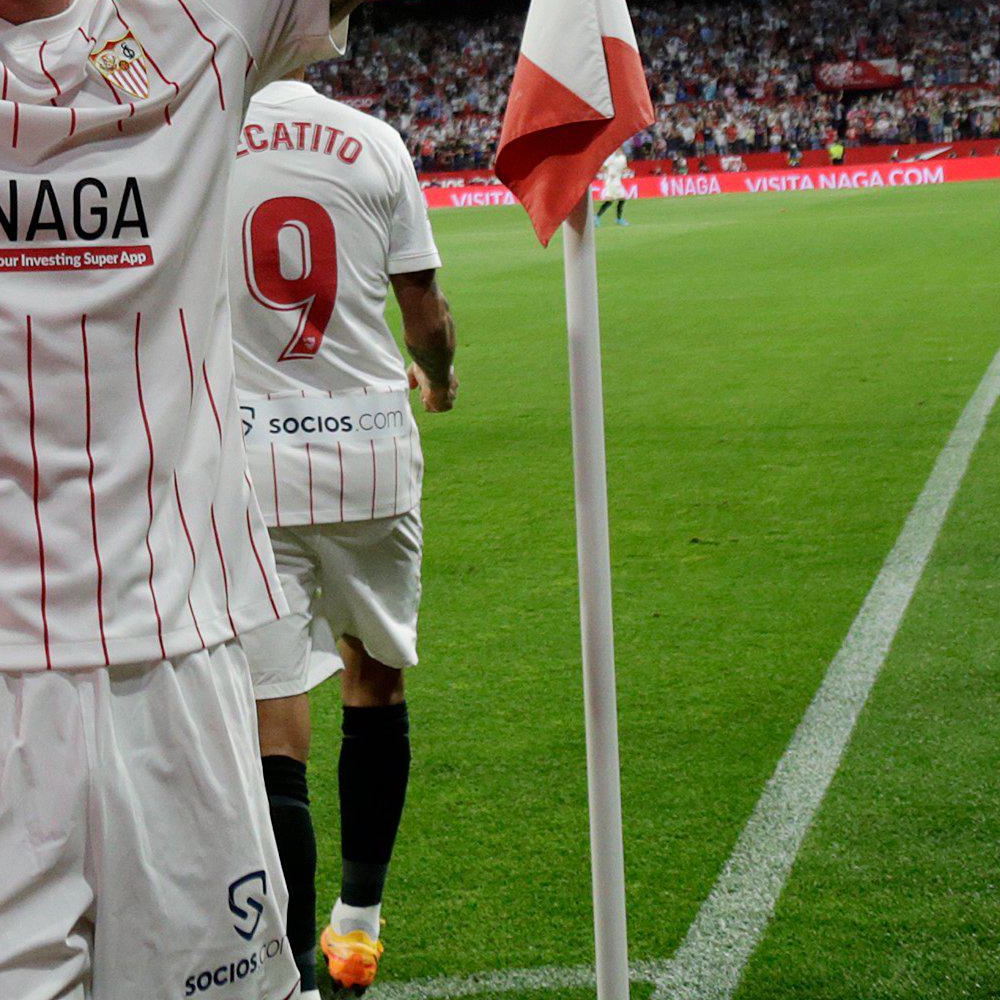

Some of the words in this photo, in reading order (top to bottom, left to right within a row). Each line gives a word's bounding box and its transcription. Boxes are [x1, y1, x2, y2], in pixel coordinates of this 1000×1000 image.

[236, 122, 363, 165] CATITO
[670, 175, 721, 196] NAGA
[745, 174, 815, 192] VISITA
[21, 253, 82, 267] Investing
[83, 252, 118, 268] Super
[120, 251, 147, 265] App
[242, 196, 338, 363] 9
[269, 410, 403, 434] SOCIOS.com
